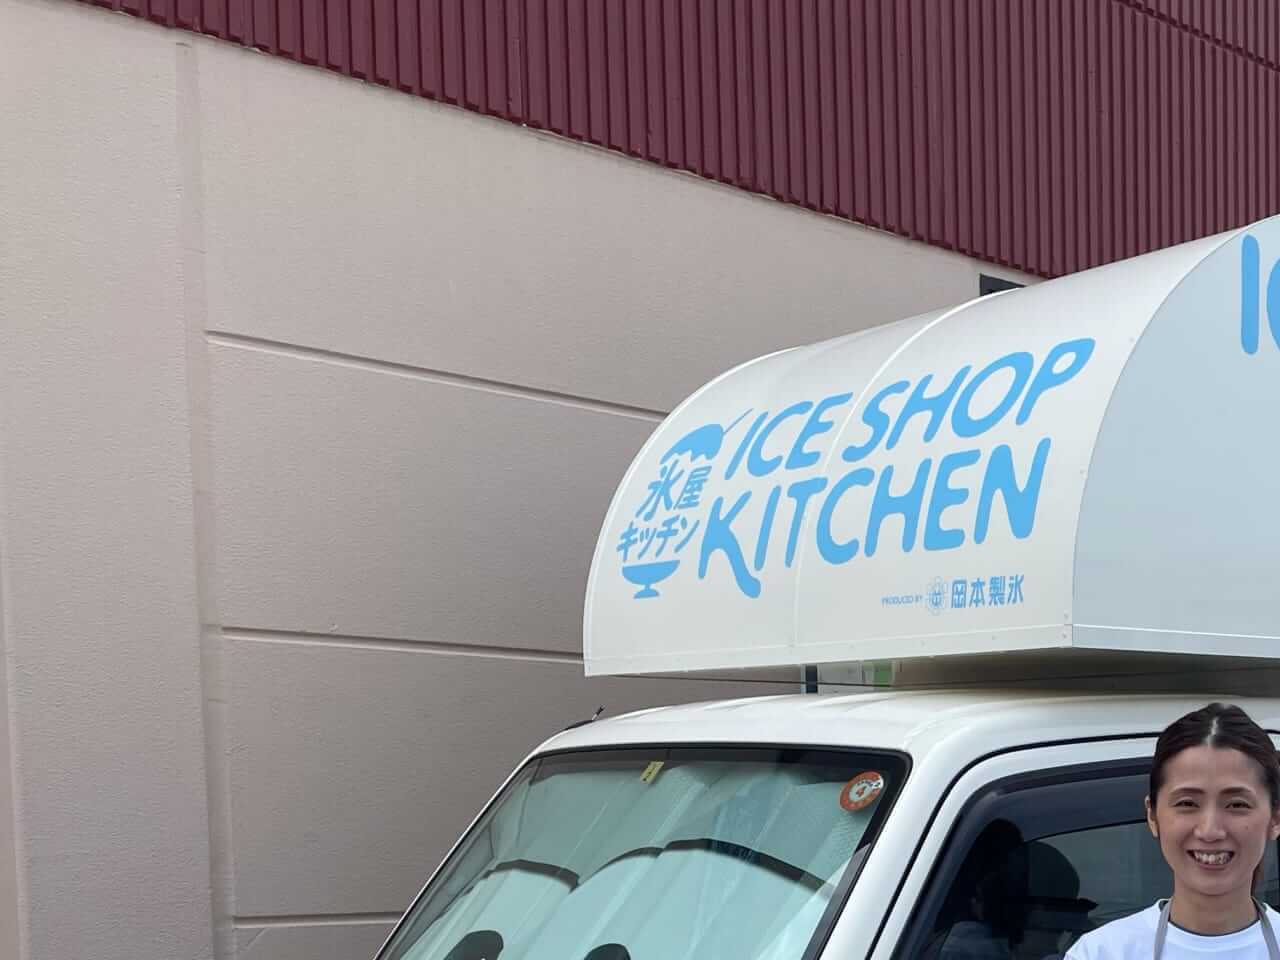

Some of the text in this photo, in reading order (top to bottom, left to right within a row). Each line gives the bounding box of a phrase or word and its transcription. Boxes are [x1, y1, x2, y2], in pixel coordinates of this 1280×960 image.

[724, 338, 1096, 481] ICE SHOP
[635, 459, 712, 522] 氷屋
[698, 437, 1051, 599] KITCHEN
[616, 514, 700, 562] キッチン
[951, 574, 1024, 608] 岡本製氷
